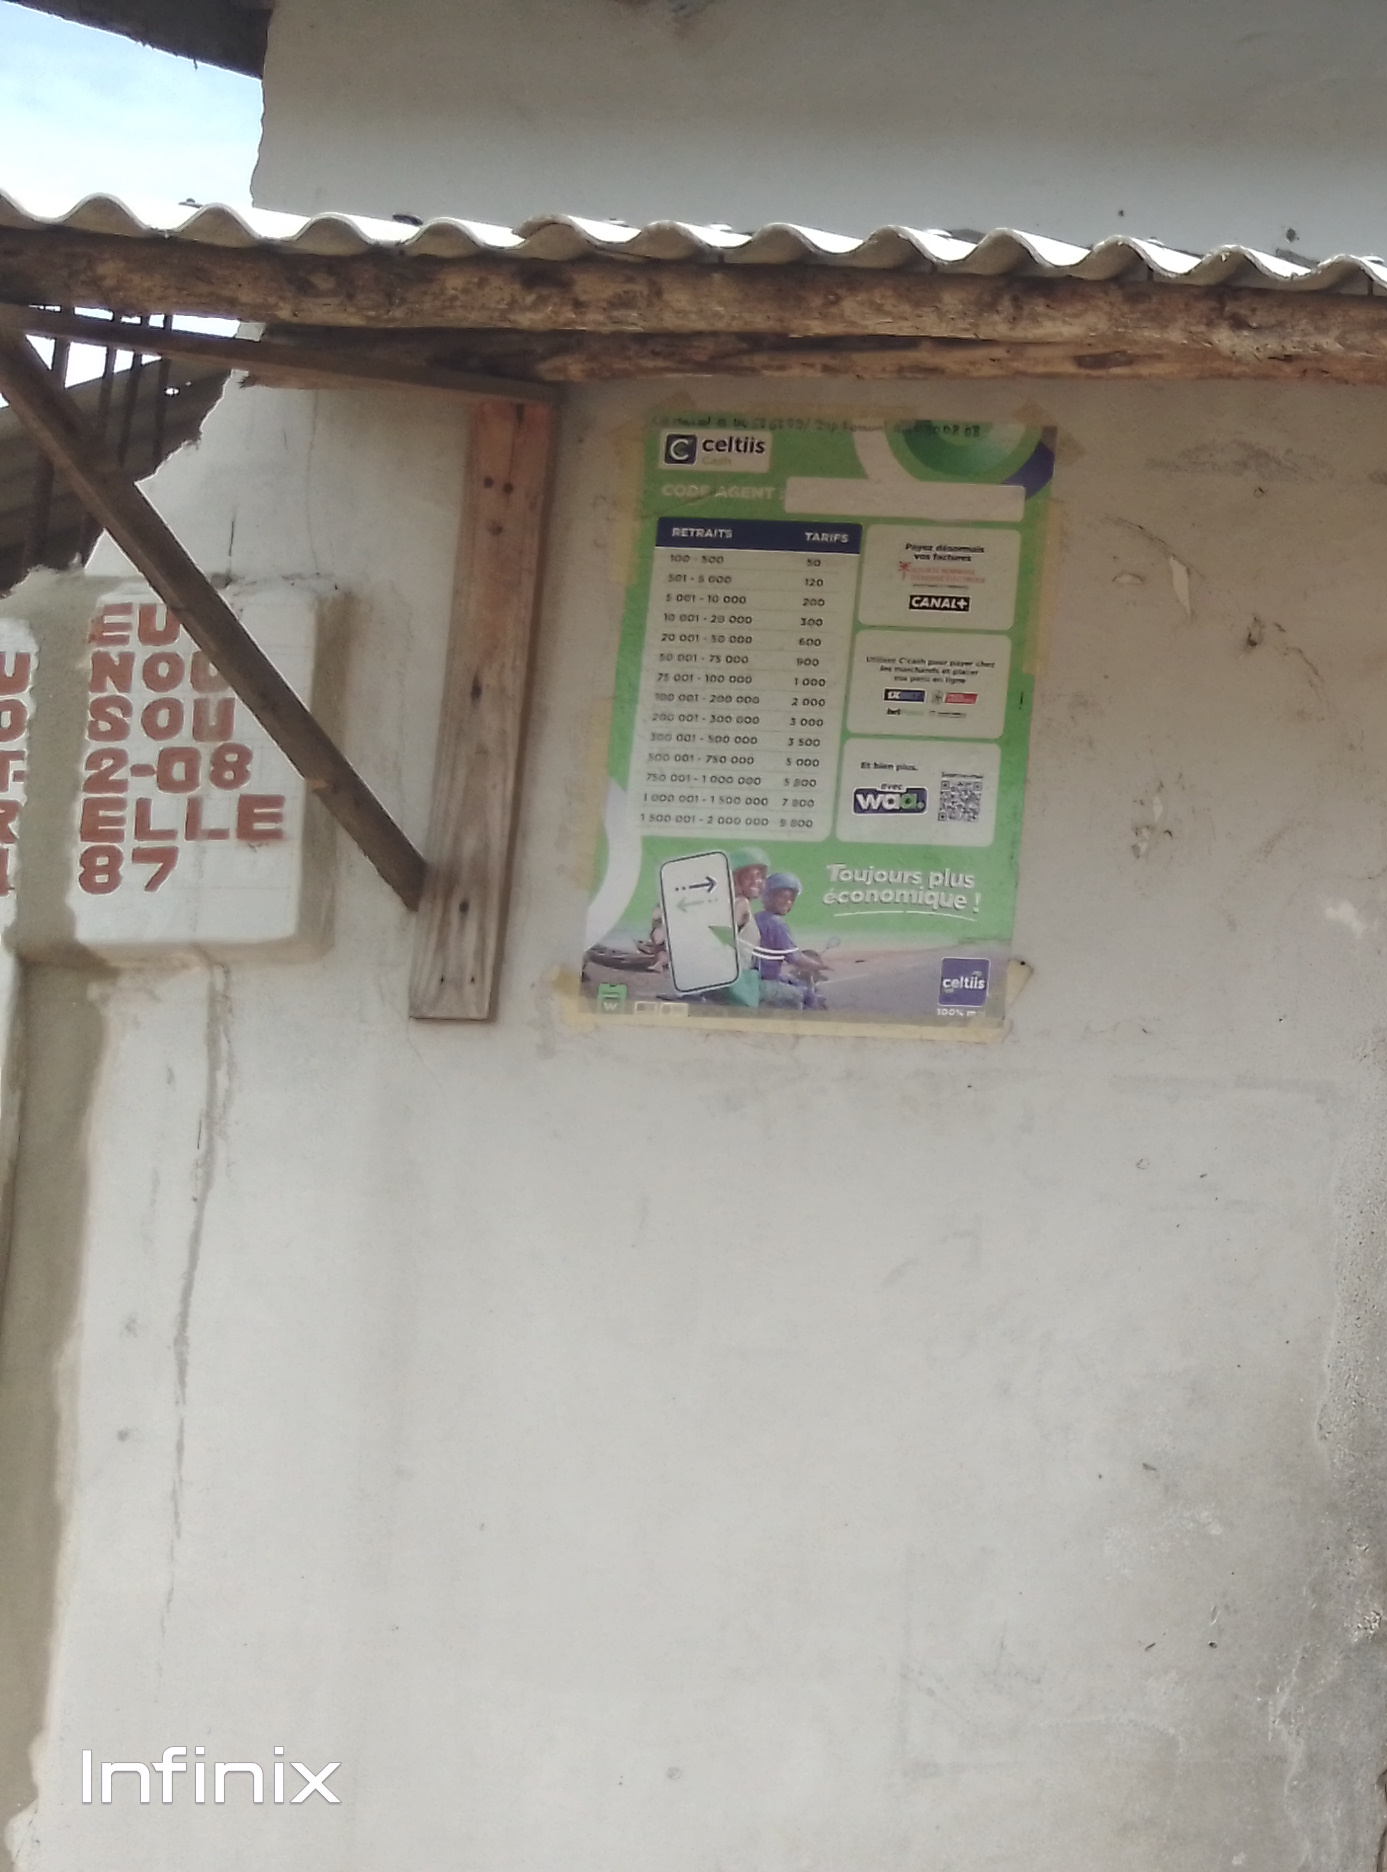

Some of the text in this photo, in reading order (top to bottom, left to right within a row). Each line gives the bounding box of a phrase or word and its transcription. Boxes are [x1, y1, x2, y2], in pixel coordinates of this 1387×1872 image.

[702, 437, 765, 455] celtiis
[662, 485, 775, 500] CODE AGENT
[672, 528, 849, 543] RETRAITS TARIFS
[906, 543, 933, 552] Payez
[805, 579, 823, 587] 120
[723, 596, 825, 607] 000 200
[912, 597, 968, 609] CANAL+
[729, 616, 752, 624] 000
[800, 618, 823, 626] 300
[661, 634, 675, 642] 20
[680, 634, 699, 642] 001
[730, 636, 752, 644] 000
[726, 656, 748, 664] 000
[674, 674, 826, 687] 001 100 000 000
[709, 695, 732, 703] 200
[736, 696, 759, 704] 000
[803, 698, 825, 707] 000
[86, 694, 236, 742] SOU
[679, 714, 698, 722] 001
[737, 716, 759, 724] 000
[801, 718, 823, 727] 000
[735, 736, 757, 744] 000
[798, 739, 820, 747] 500
[706, 755, 726, 764] 750
[731, 756, 754, 764] 000
[797, 759, 819, 767] 000
[83, 742, 253, 794] 2-08
[710, 776, 733, 784] 000
[738, 777, 761, 785] 000
[79, 794, 286, 844] ELLE
[718, 817, 741, 825] 000
[746, 818, 768, 826] 000
[78, 845, 179, 895] 87
[827, 863, 975, 889] Toujours plus
[823, 886, 981, 913] économique !
[943, 976, 985, 989] celtiis
[937, 1008, 963, 1016] 100%
